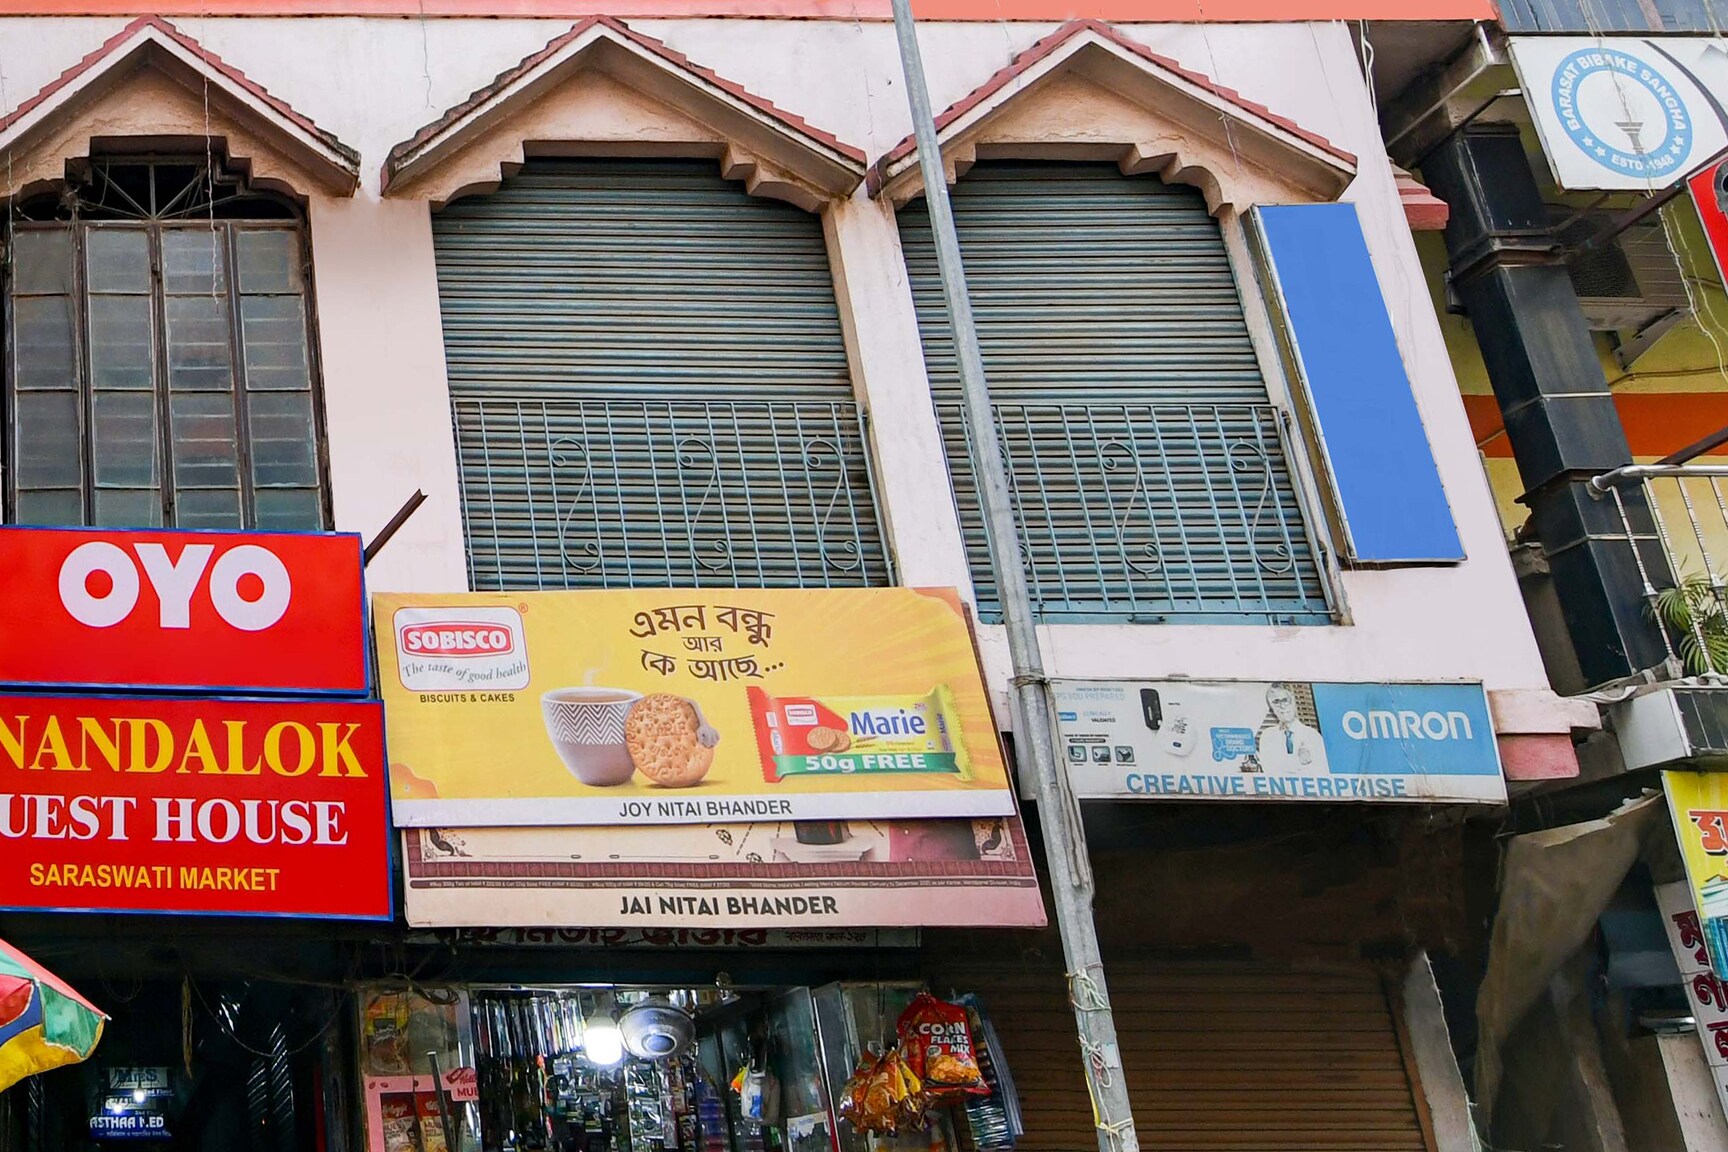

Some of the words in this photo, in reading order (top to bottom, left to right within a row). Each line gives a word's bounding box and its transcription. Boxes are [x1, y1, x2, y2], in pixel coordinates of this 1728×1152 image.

[1558, 62, 1580, 131] BARASAT
[1640, 68, 1687, 130] SANGHA
[59, 542, 291, 631] OYO
[629, 605, 706, 638] এমন
[713, 605, 775, 648] বন্ধু
[407, 630, 507, 650] SOBISCO
[681, 636, 722, 652] আর
[403, 662, 424, 677] The
[427, 663, 453, 674] taste
[456, 669, 469, 681] of
[468, 669, 492, 682] good
[496, 661, 526, 679] health
[641, 649, 676, 676] কে
[420, 694, 467, 703] BISCUITS
[480, 693, 515, 702] CAKES
[851, 709, 925, 736] Marie
[806, 755, 855, 772] 50g
[864, 754, 927, 769] FREE
[1126, 774, 1247, 795] CREATIVE
[1254, 776, 1407, 798] ENTERPRISE
[619, 800, 652, 818] JOY
[656, 800, 701, 817] NITAI
[706, 799, 792, 816] BHANDER
[152, 798, 348, 846] HOUSE
[29, 864, 171, 889] SARASWATI
[179, 866, 280, 891] MARKET
[620, 896, 651, 915] JAI
[659, 896, 720, 915] NITAI
[727, 896, 838, 916] BHANDER
[919, 1022, 966, 1035] CORN
[930, 1035, 969, 1045] FLAKES
[950, 1045, 970, 1054] MIX
